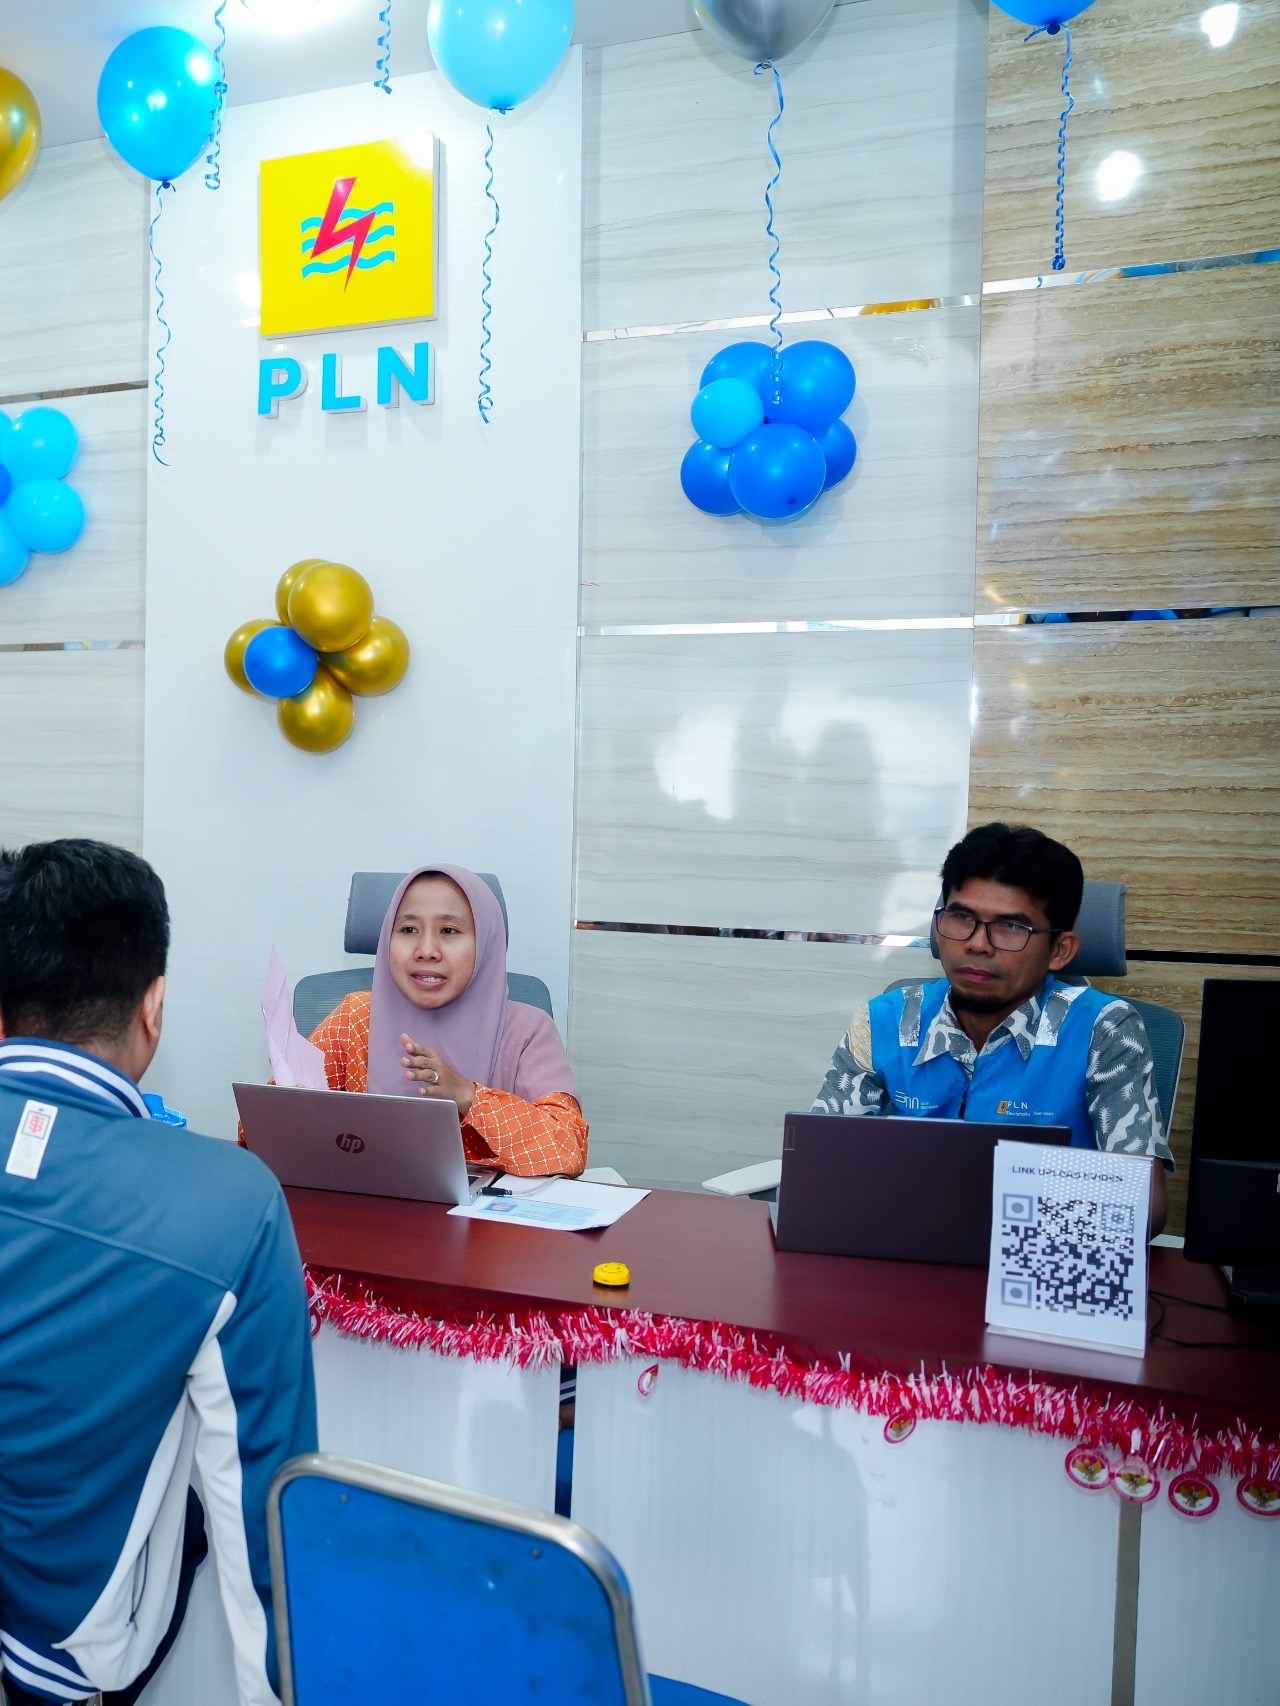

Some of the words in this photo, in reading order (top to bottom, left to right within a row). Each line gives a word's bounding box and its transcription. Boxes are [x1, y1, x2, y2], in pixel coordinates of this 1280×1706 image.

[258, 342, 433, 416] PLN
[1008, 1101, 1028, 1109] PLN
[340, 1133, 362, 1153] hp
[1012, 1166, 1035, 1175] LINK
